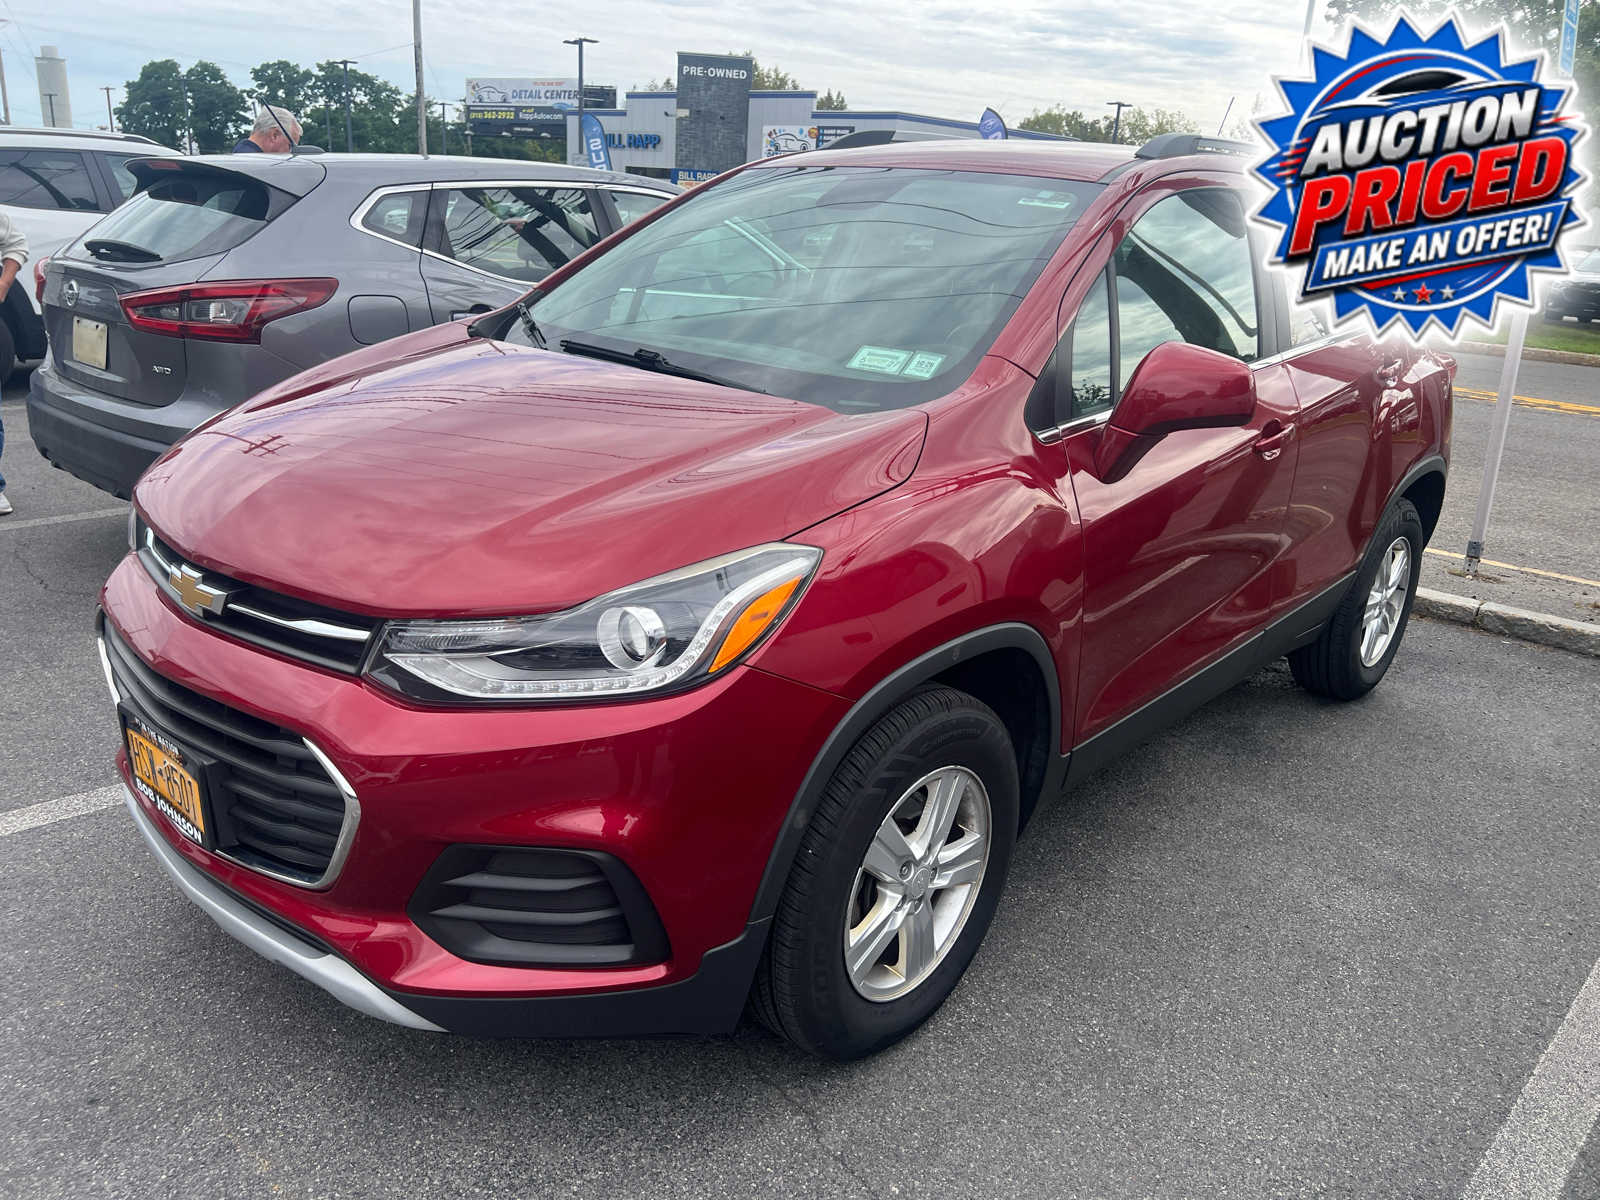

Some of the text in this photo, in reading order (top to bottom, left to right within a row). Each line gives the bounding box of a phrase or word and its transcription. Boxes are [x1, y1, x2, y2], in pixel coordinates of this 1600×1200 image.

[683, 65, 747, 80] PRE-OWNED
[512, 89, 579, 100] DETAIL CENTER
[605, 133, 661, 149] ILL RAPP
[678, 171, 695, 181] BILL
[135, 777, 203, 843] BOB JOHNSON
